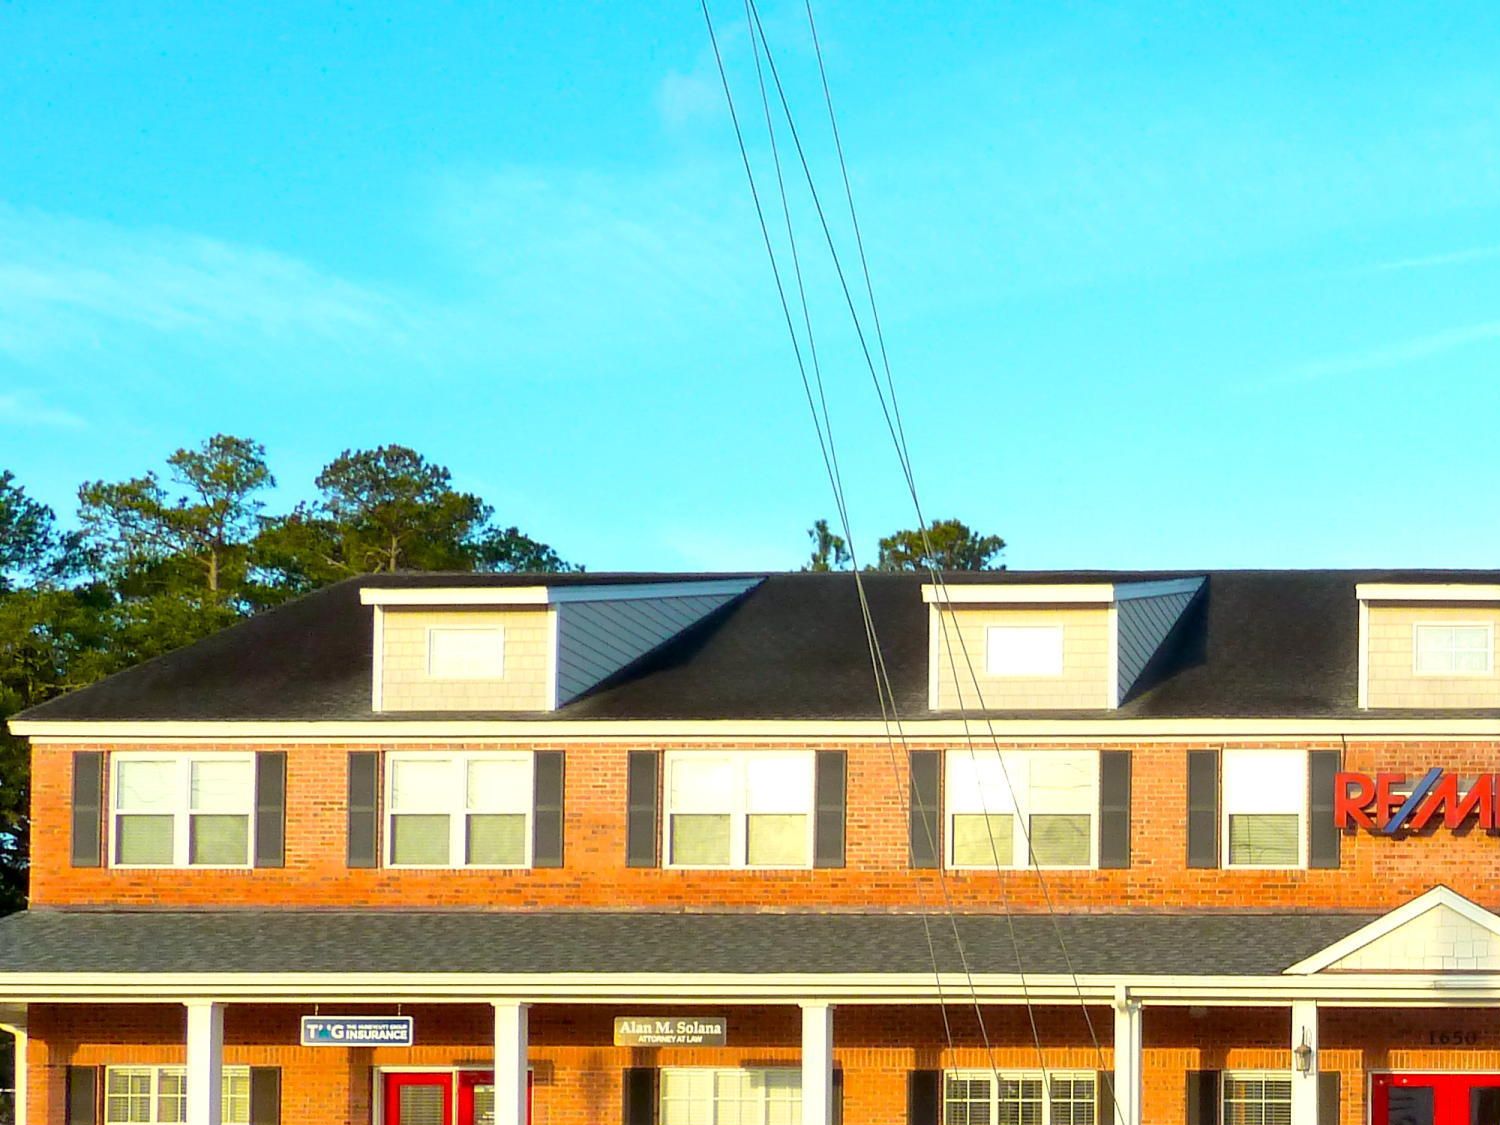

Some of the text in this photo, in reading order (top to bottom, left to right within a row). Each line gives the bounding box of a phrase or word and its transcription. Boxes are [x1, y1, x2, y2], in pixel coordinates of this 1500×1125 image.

[619, 1021, 722, 1034] Alan M. Solana
[345, 1030, 408, 1040] INSURANCE
[638, 1035, 703, 1043] ATTORNEY AT LAW
[1429, 1030, 1477, 1045] 1650
